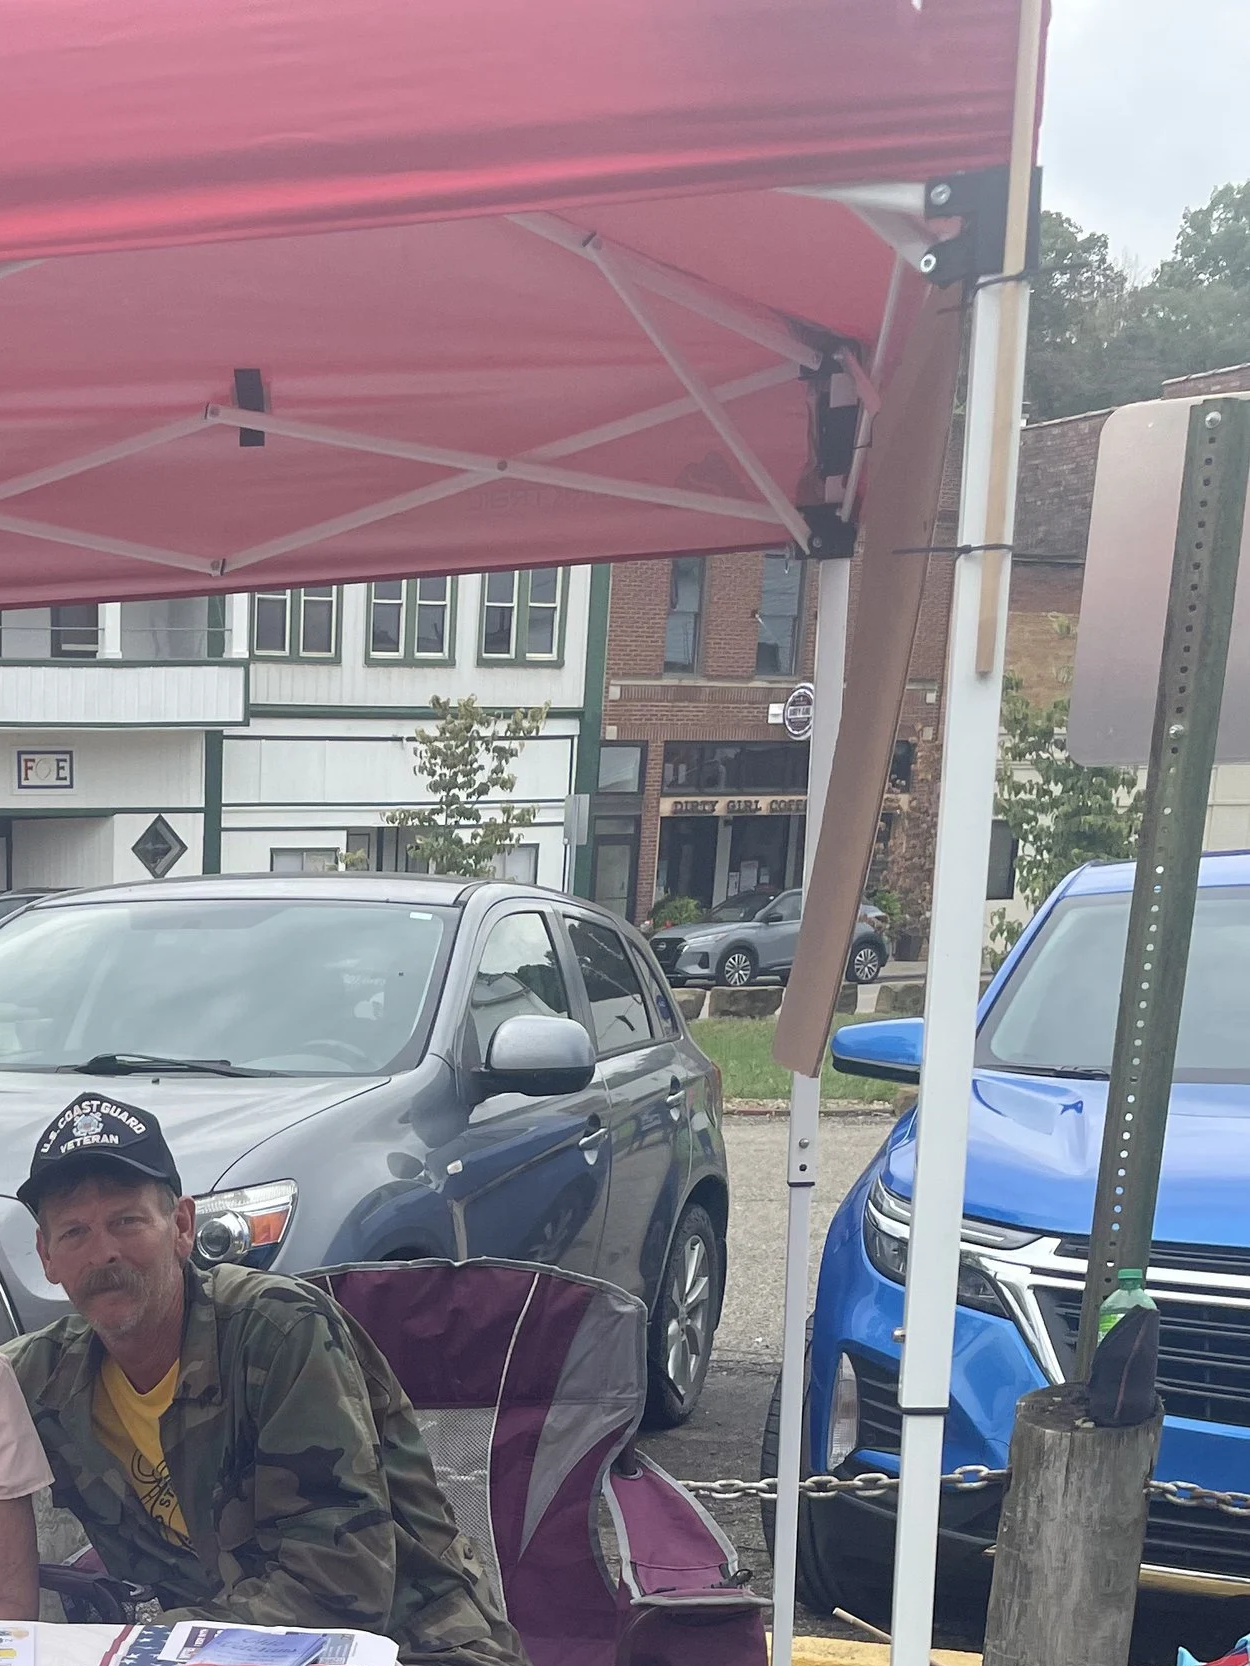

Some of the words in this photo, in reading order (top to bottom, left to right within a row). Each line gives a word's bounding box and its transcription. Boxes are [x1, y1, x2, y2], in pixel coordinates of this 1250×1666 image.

[671, 799, 719, 815] DIRTY
[727, 799, 763, 814] GIRL
[57, 1100, 101, 1130] COAST
[100, 1101, 147, 1135] GUARD
[59, 1133, 119, 1154] VETERAN
